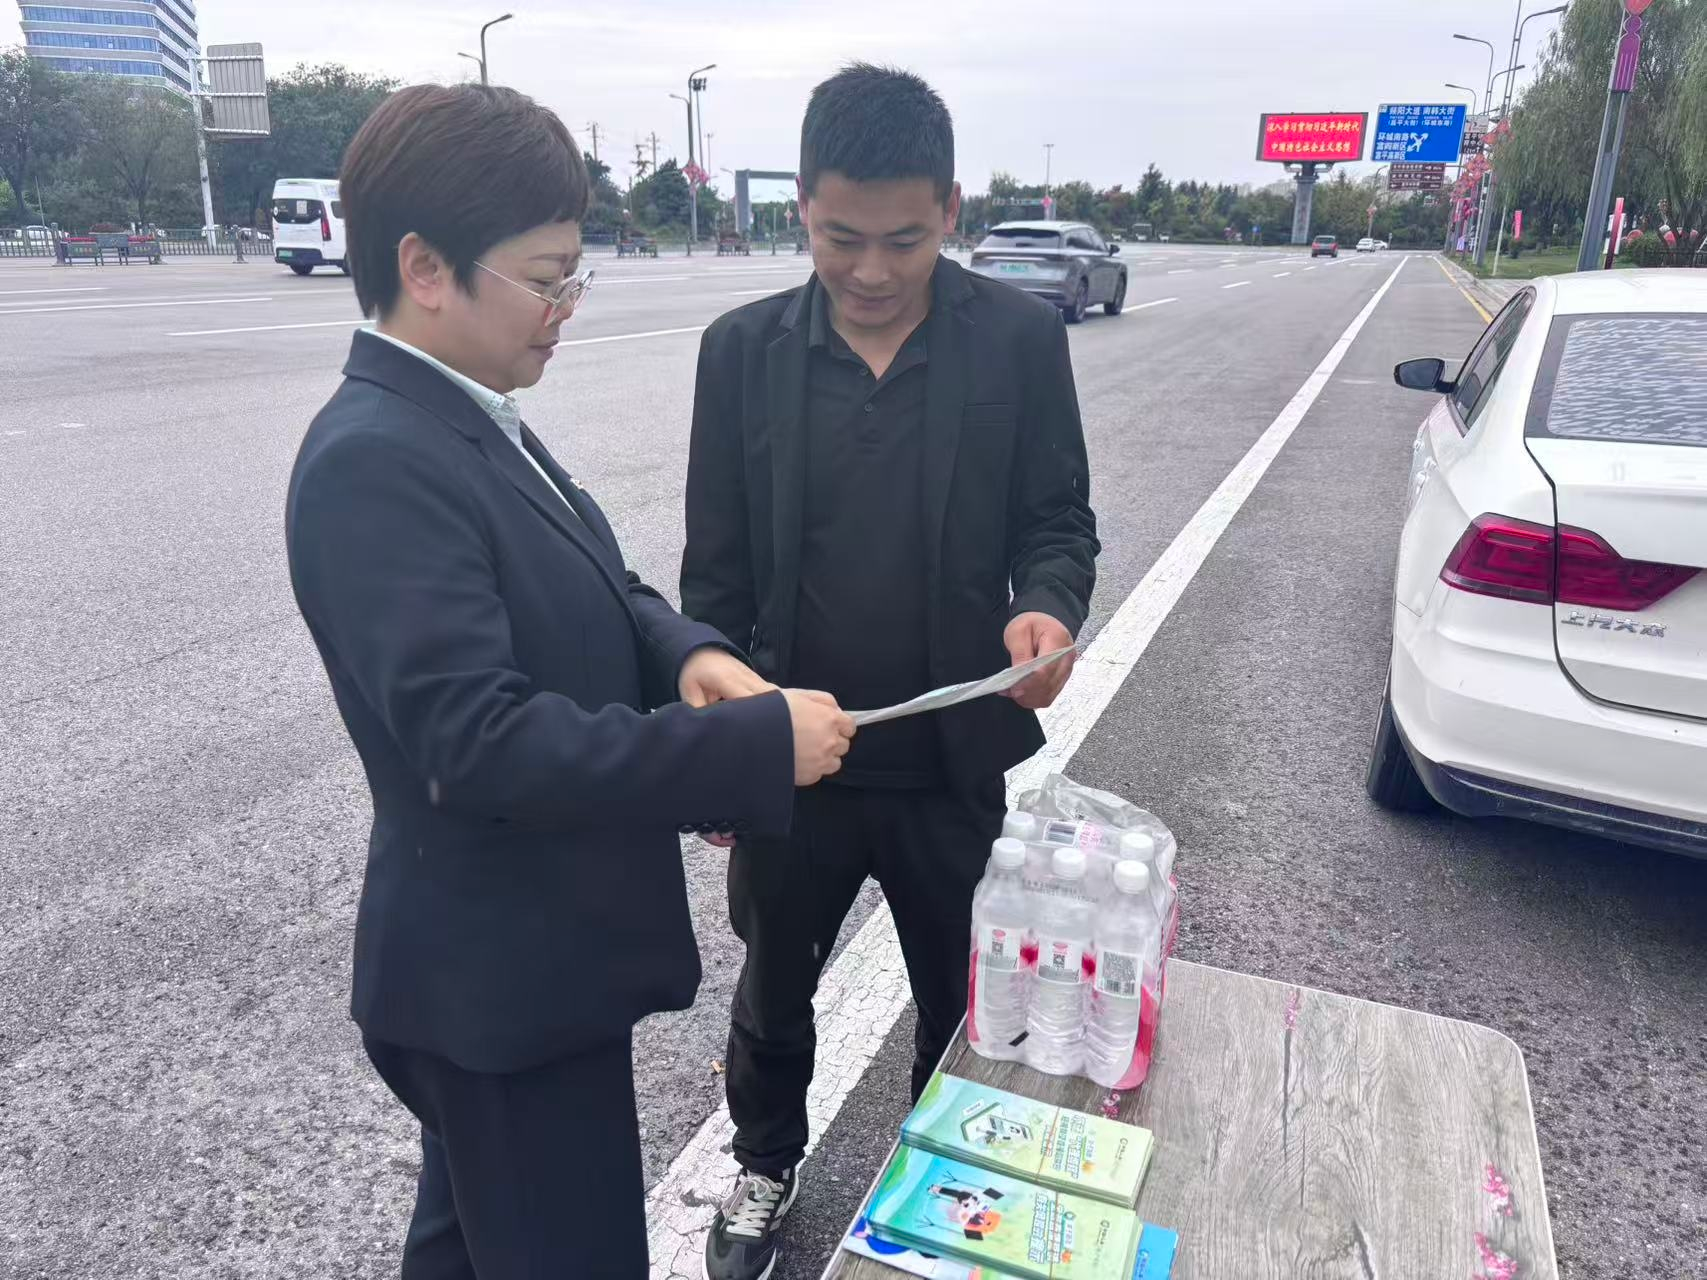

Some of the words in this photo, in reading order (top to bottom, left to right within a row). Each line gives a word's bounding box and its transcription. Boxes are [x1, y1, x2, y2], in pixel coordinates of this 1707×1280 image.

[1271, 142, 1351, 153] 中国特色社会主义思想
